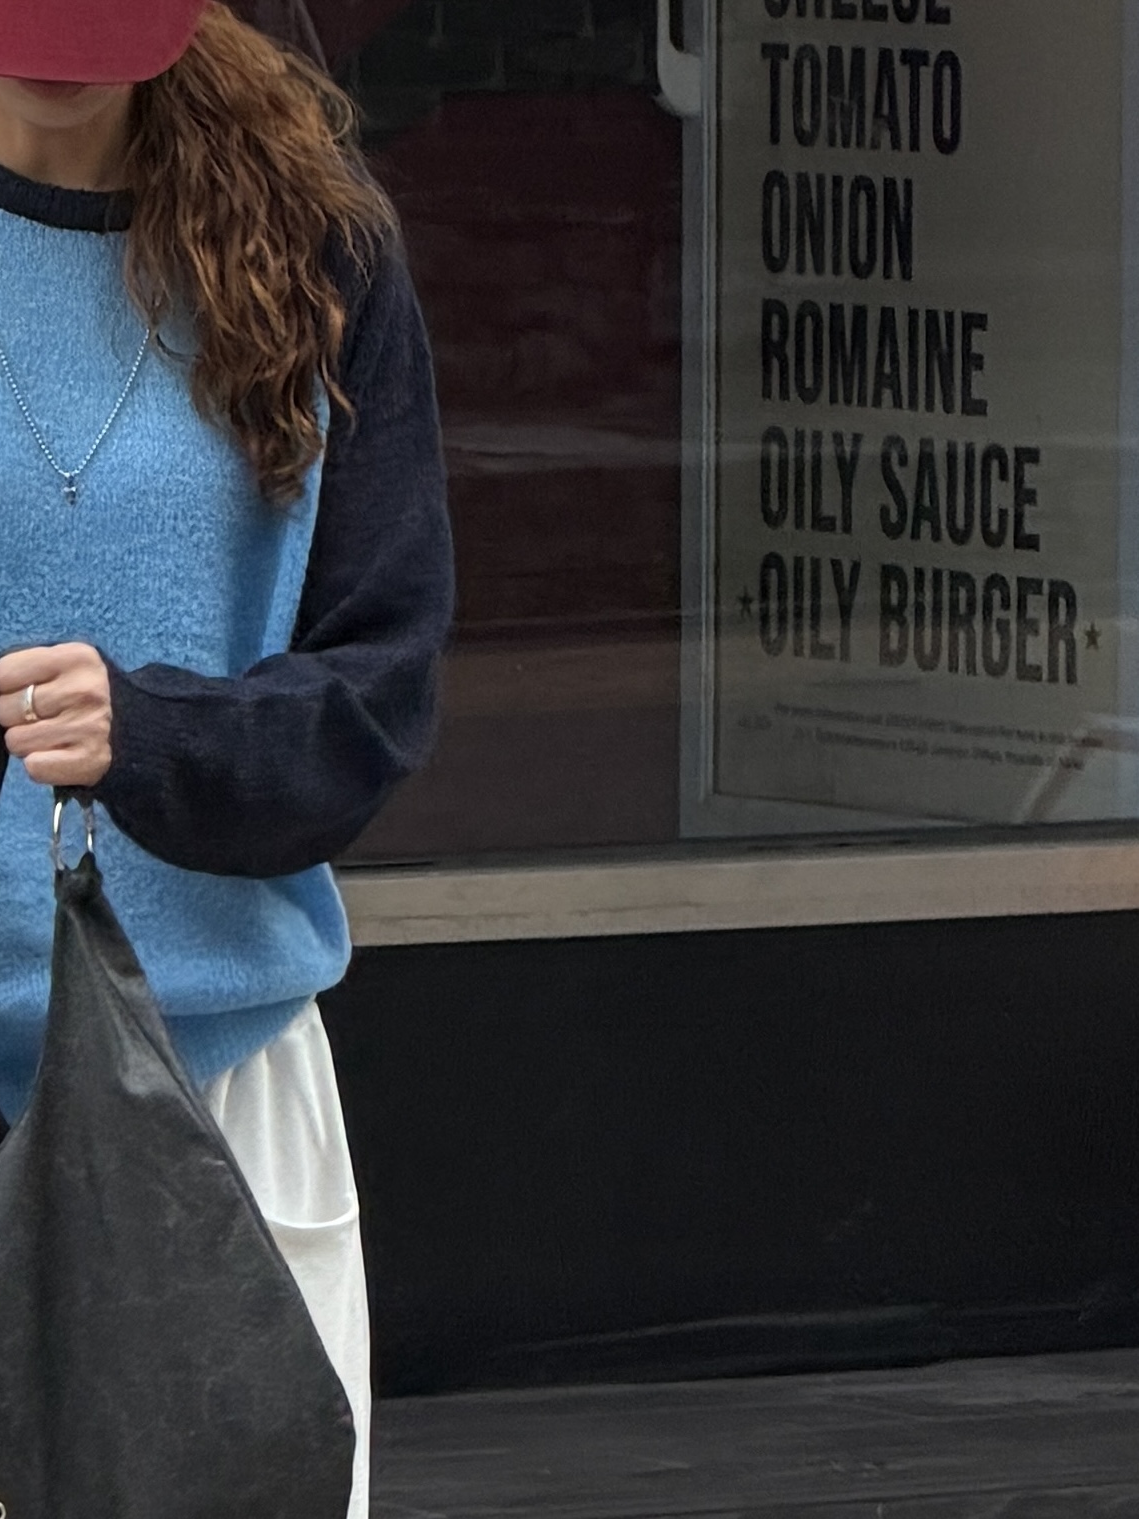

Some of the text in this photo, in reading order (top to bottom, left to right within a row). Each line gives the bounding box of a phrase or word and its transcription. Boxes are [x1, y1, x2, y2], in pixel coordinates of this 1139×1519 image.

[761, 43, 961, 154] TOMATO
[762, 170, 913, 280] ONION
[762, 298, 988, 417] ROMAINE
[761, 426, 1041, 552] OILY SAUCE
[761, 552, 1078, 684] OILY BURGER
